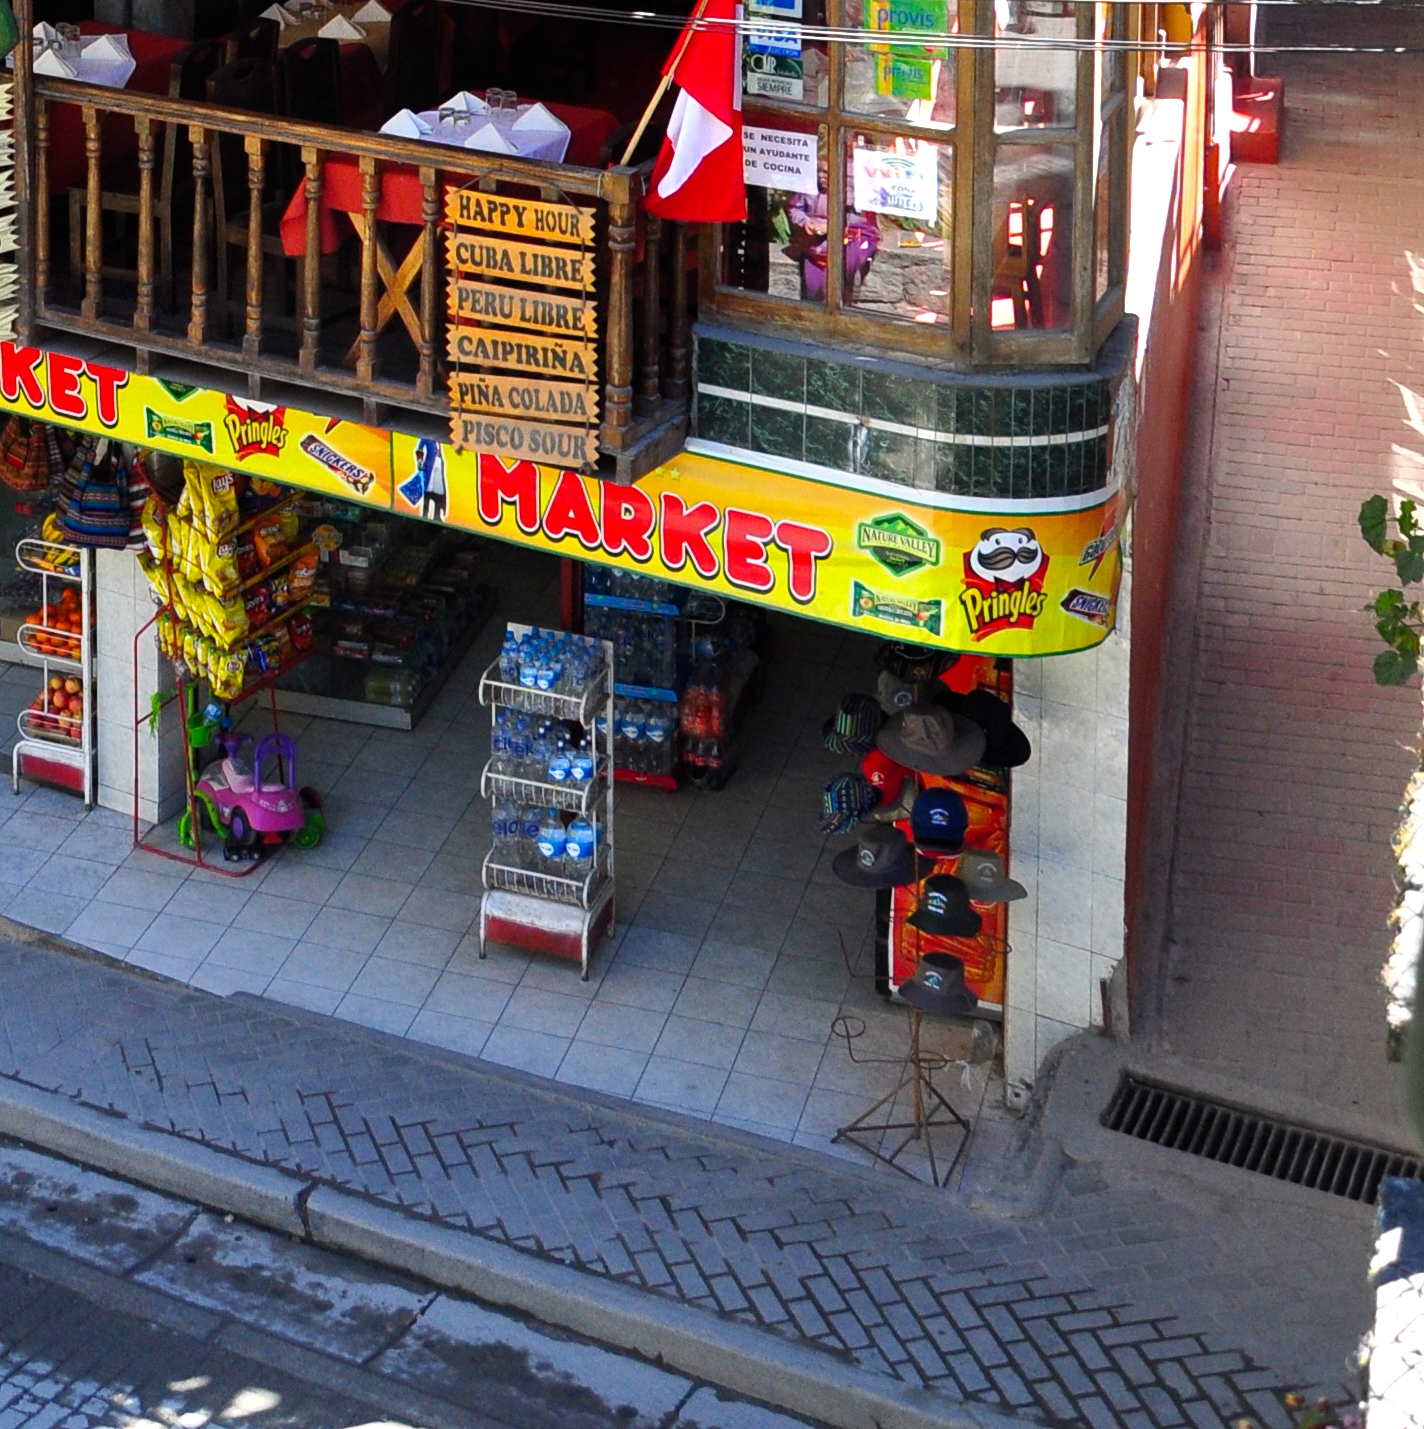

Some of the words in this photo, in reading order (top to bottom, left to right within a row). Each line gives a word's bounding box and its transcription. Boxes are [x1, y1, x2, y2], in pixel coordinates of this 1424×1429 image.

[759, 148, 810, 161] AYUDANTE
[761, 134, 809, 147] NECESITA
[744, 159, 758, 167] DE
[763, 161, 801, 175] COCINA
[458, 194, 527, 228] HAPPY
[534, 209, 581, 239] HOUR
[455, 243, 514, 272] CUBA
[519, 251, 584, 283] LIBRE
[457, 287, 513, 319] PERU
[519, 297, 585, 331] LIBRE
[457, 334, 587, 374] CAIPIRIÑA
[458, 378, 504, 408] PIÑA
[508, 386, 587, 415] COLADA
[224, 412, 288, 454] Pringles
[462, 419, 523, 450] PISCO
[527, 428, 587, 461] SOUR
[310, 442, 366, 478] SNICKERS
[476, 452, 833, 603] MARKET
[862, 526, 898, 545] NATURE
[899, 535, 936, 558] VALLEY
[960, 582, 1047, 633] Pringles
